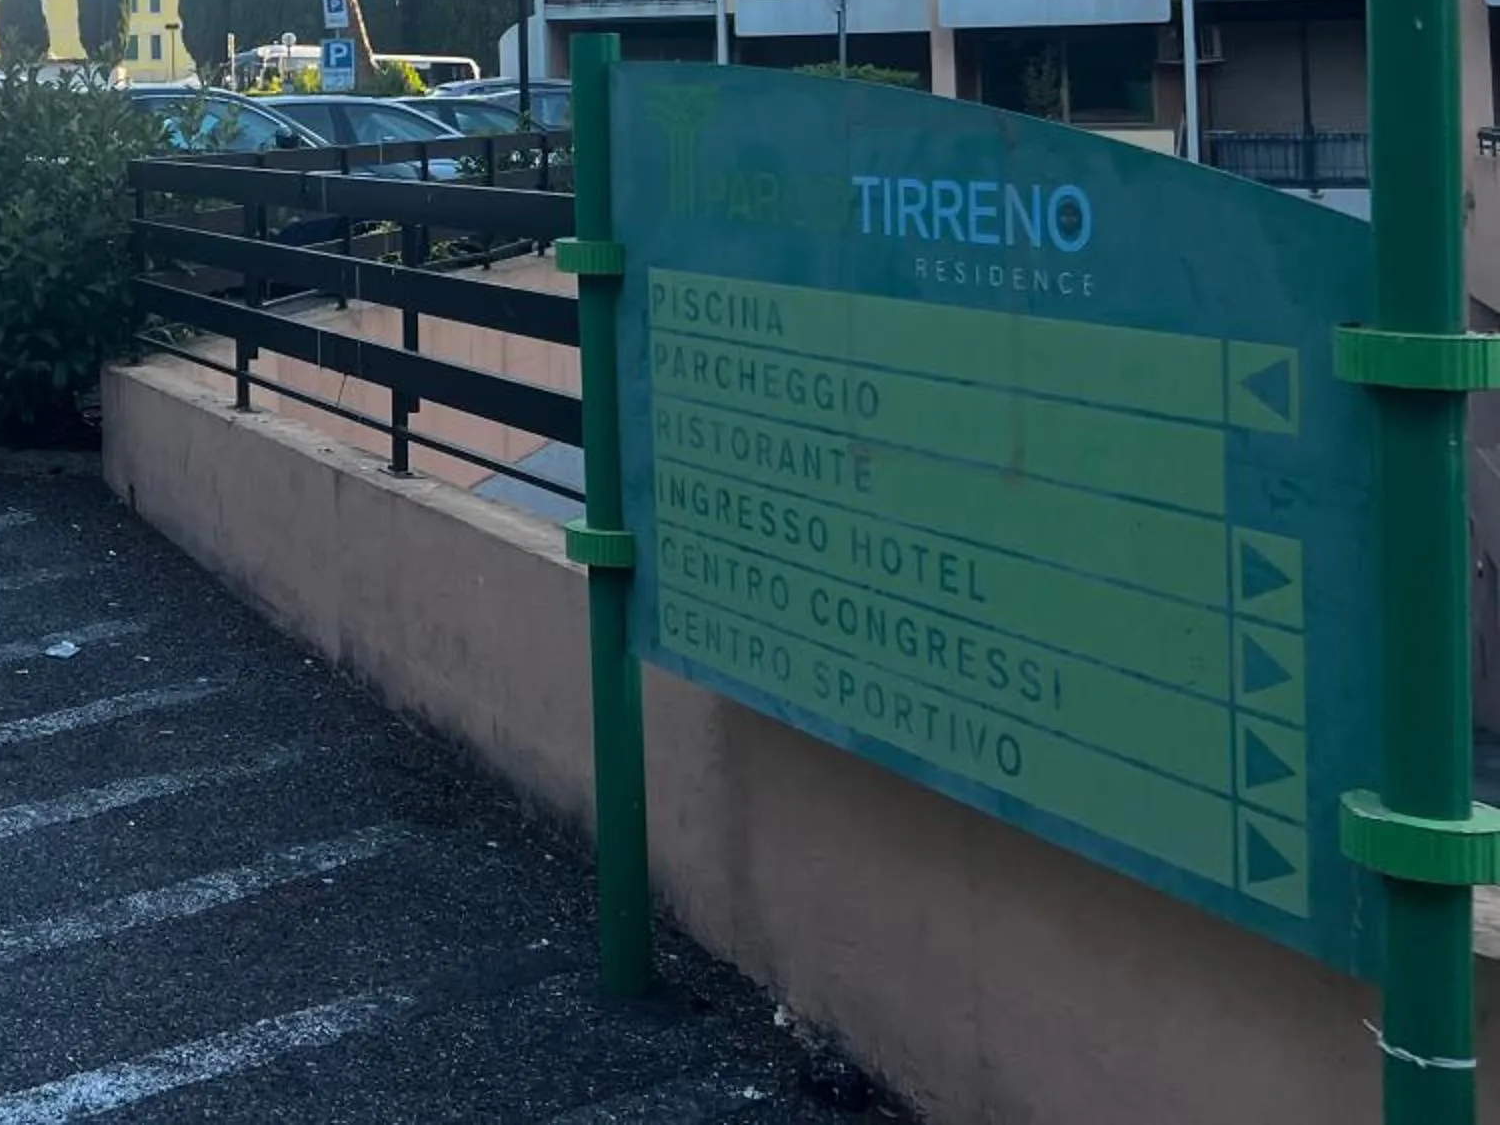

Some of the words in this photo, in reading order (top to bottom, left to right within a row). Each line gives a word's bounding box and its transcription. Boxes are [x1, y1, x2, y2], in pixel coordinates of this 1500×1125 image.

[330, 0, 342, 11] P
[330, 43, 348, 66] P
[852, 176, 1091, 252] TIRRENO
[652, 283, 783, 336] PISCINA
[915, 258, 1095, 296] RESIDENCE
[654, 341, 879, 419] PARCHEGGIO
[656, 408, 873, 493] RISTORANTE
[658, 471, 828, 553] INGRESSO
[851, 526, 987, 604] HOTEL
[661, 536, 790, 611] CENTRO
[810, 588, 1062, 710] CONGRESSI
[663, 602, 792, 682] CENTRO
[814, 661, 1023, 777] SPORTIVO
